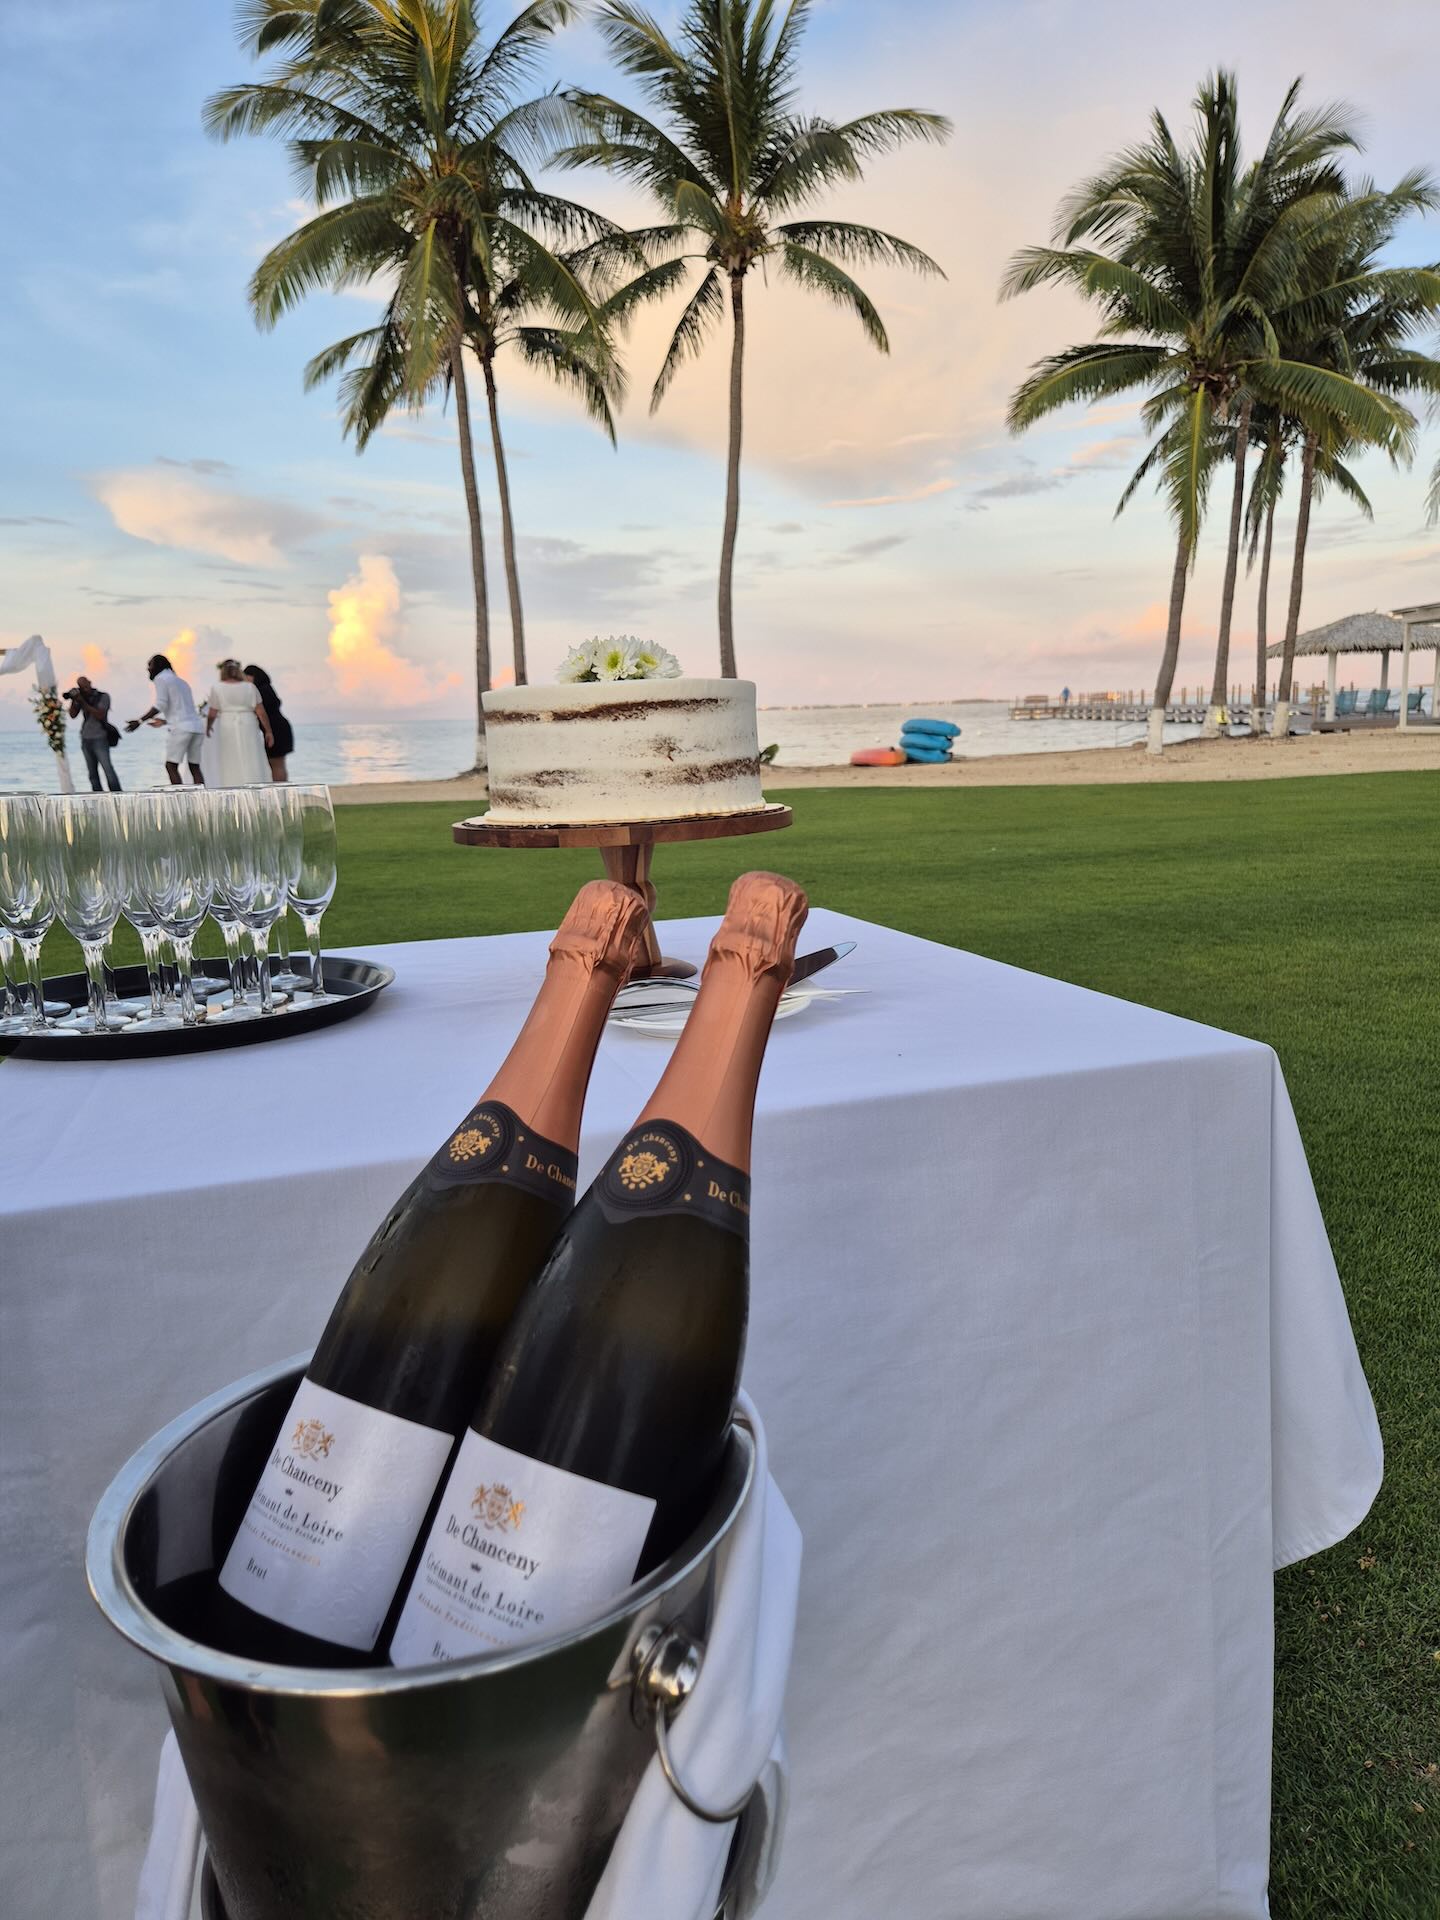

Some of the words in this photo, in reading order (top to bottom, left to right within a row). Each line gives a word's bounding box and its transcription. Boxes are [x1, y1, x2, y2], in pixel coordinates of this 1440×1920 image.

[525, 1153, 545, 1173] De
[707, 1180, 727, 1201] De
[271, 1448, 281, 1467] De
[281, 1455, 344, 1503] Chanceny
[283, 1503, 299, 1522] de
[302, 1511, 344, 1542] Loire
[445, 1513, 461, 1538] De
[461, 1523, 541, 1580] Chanceny
[246, 1557, 269, 1580] Brut
[471, 1580, 490, 1602] de
[495, 1591, 545, 1624] Loire
